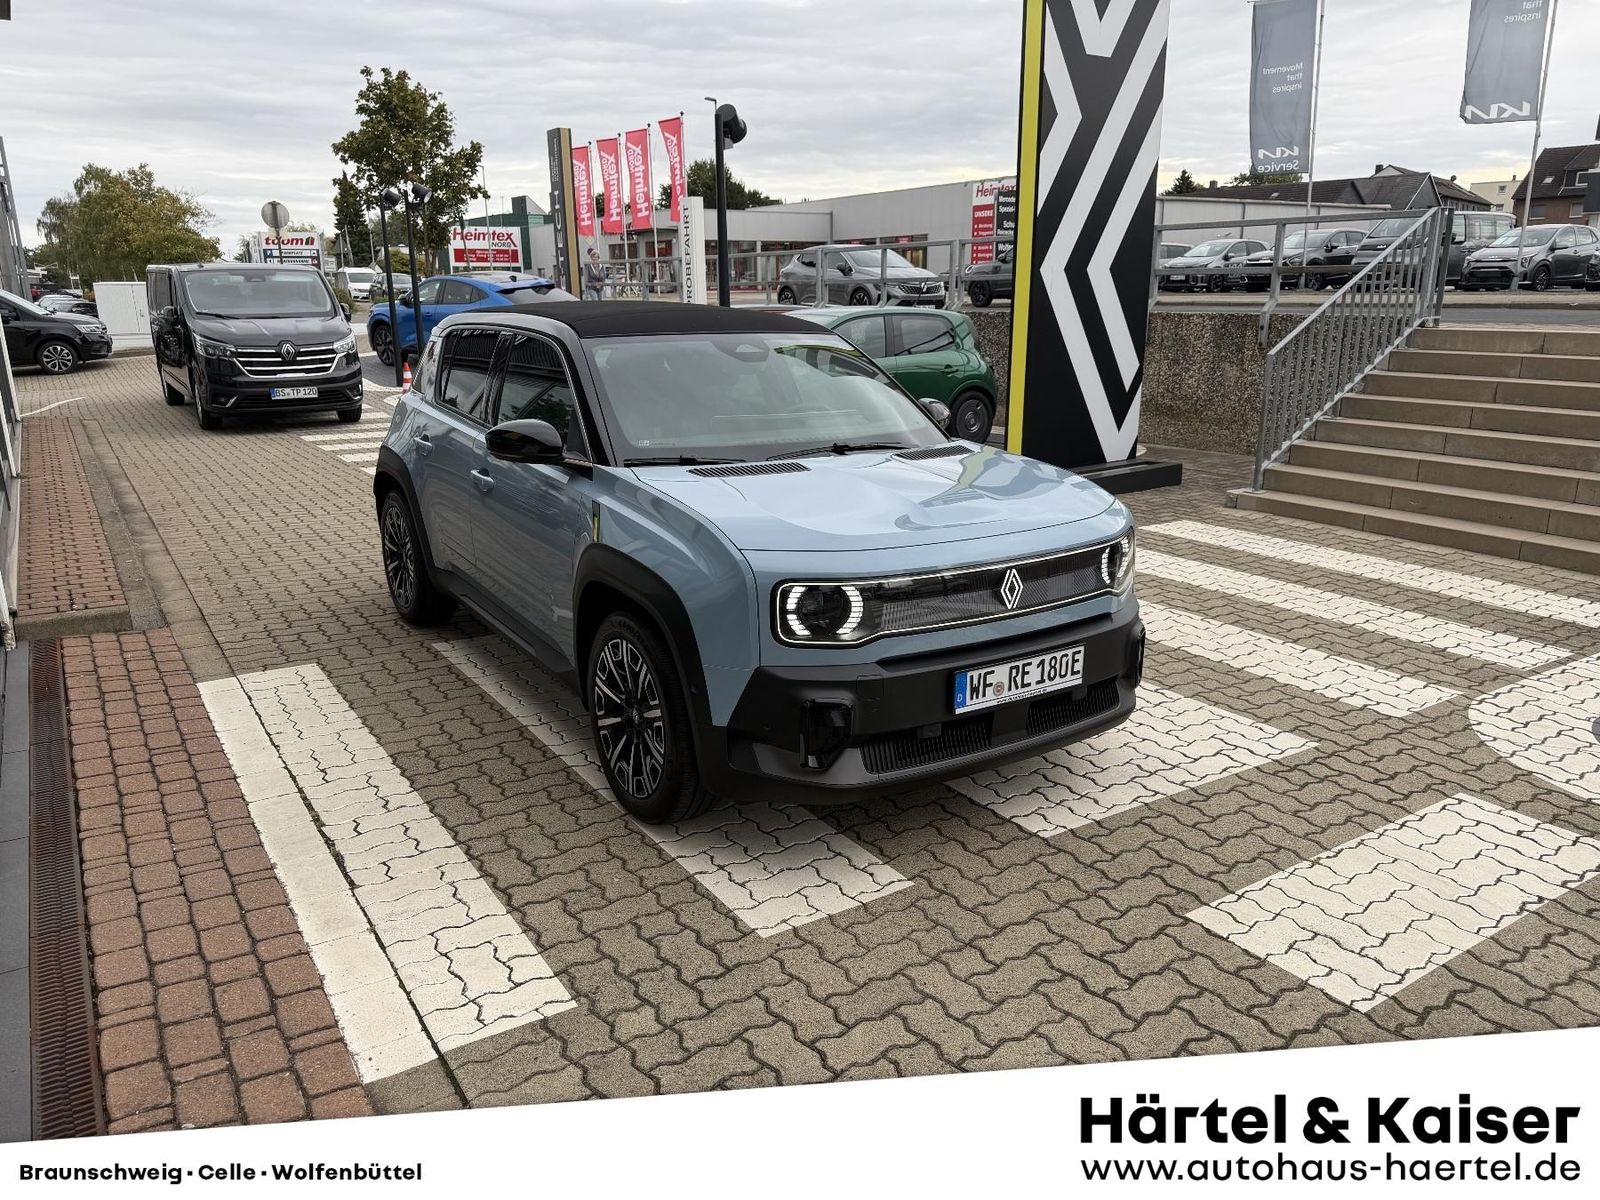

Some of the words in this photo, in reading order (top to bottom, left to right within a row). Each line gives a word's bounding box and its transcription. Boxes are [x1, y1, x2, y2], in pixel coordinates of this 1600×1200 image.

[453, 228, 517, 247] Heimtex
[683, 203, 693, 303] ROBEFAHRT
[276, 389, 286, 397] BS
[303, 387, 316, 395] 120
[970, 670, 995, 701] WF
[1008, 661, 1032, 692] RE
[1035, 650, 1082, 685] 180E
